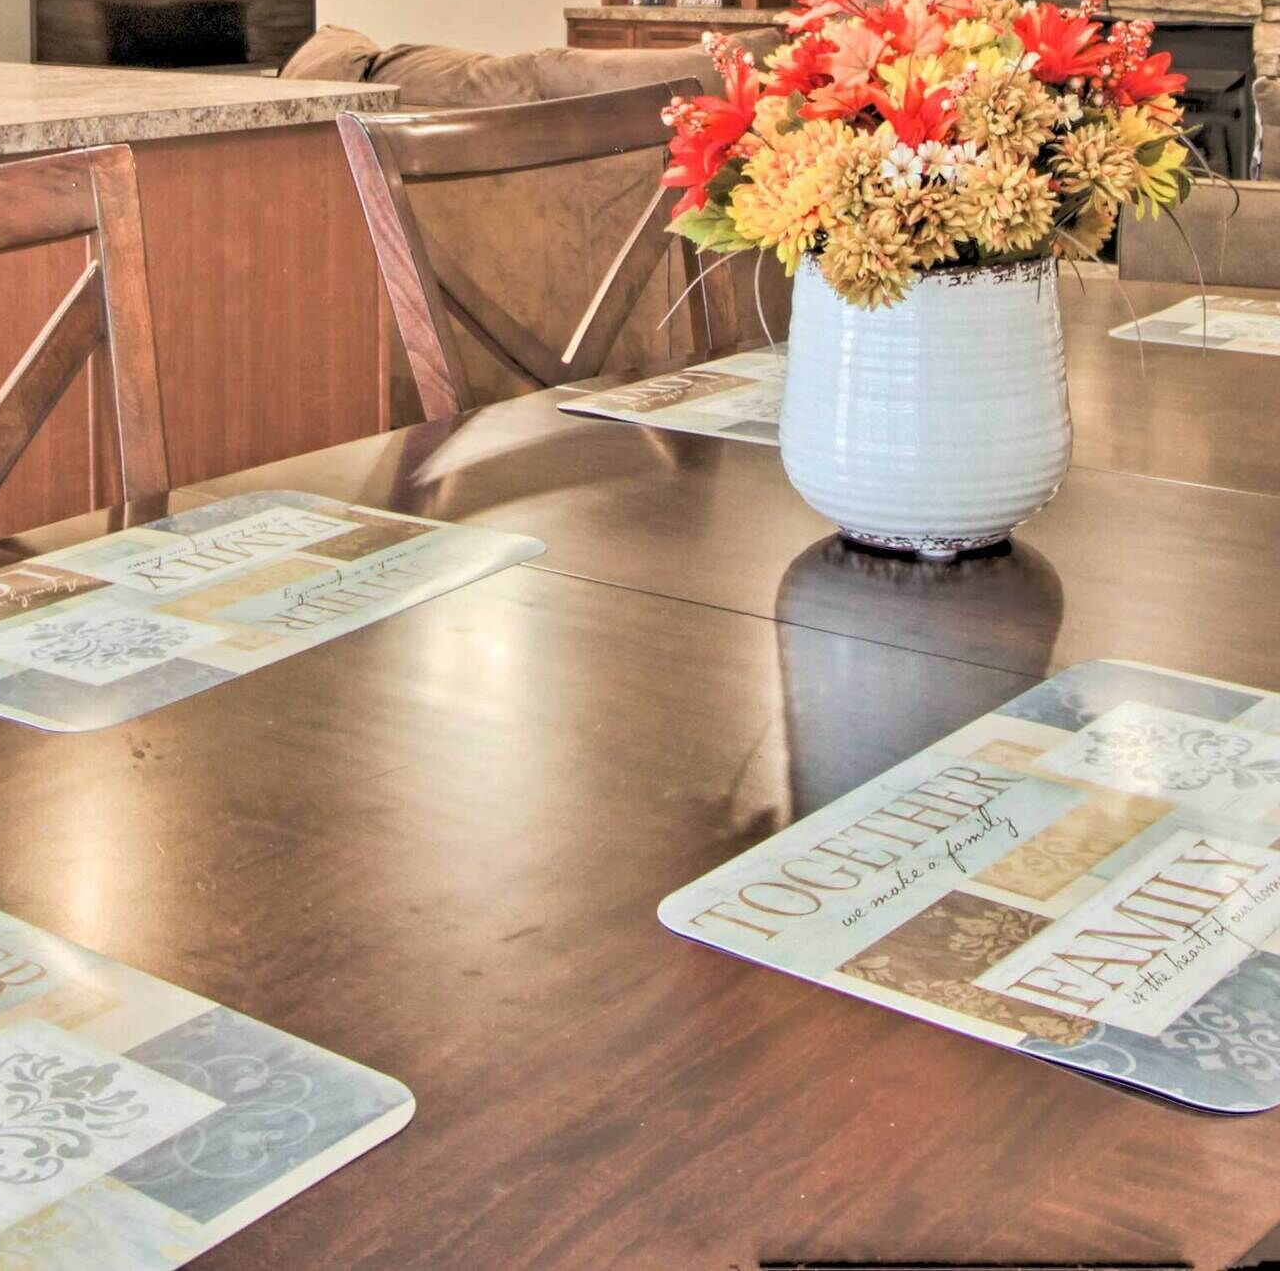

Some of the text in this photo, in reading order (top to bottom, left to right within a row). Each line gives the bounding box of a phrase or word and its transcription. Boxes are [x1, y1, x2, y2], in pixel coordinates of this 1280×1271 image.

[129, 515, 343, 590] FAMILY
[688, 765, 1028, 942] TOGETHER
[841, 907, 866, 929] we
[870, 867, 926, 908] make
[945, 804, 1019, 874] family
[1006, 839, 1269, 1013] FAMILY
[1135, 971, 1174, 993] the
[1163, 920, 1214, 973] heart
[1230, 902, 1255, 924] our
